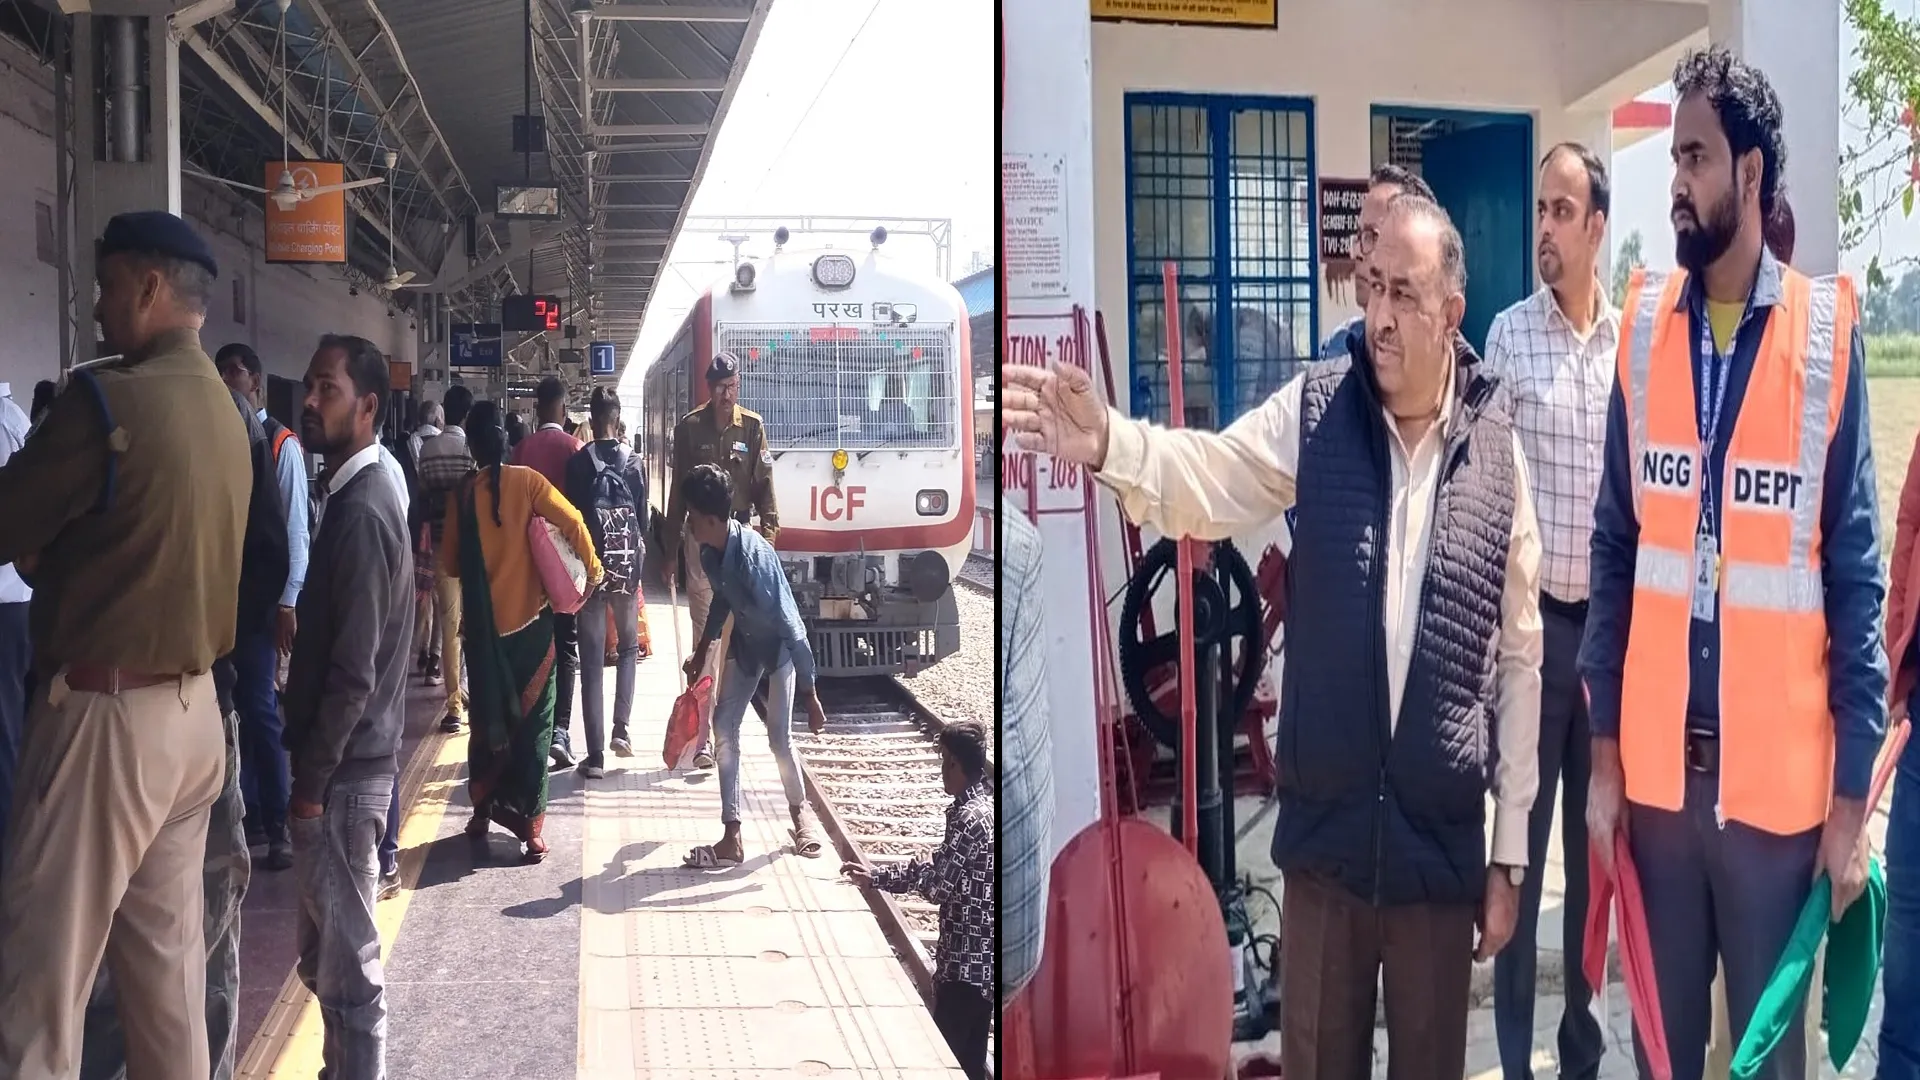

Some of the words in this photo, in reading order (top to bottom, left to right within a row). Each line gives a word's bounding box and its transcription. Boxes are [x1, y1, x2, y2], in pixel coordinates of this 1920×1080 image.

[812, 302, 864, 319] परख
[597, 348, 606, 369] 1
[1734, 467, 1803, 510] DEPT
[810, 485, 867, 521] ICF
